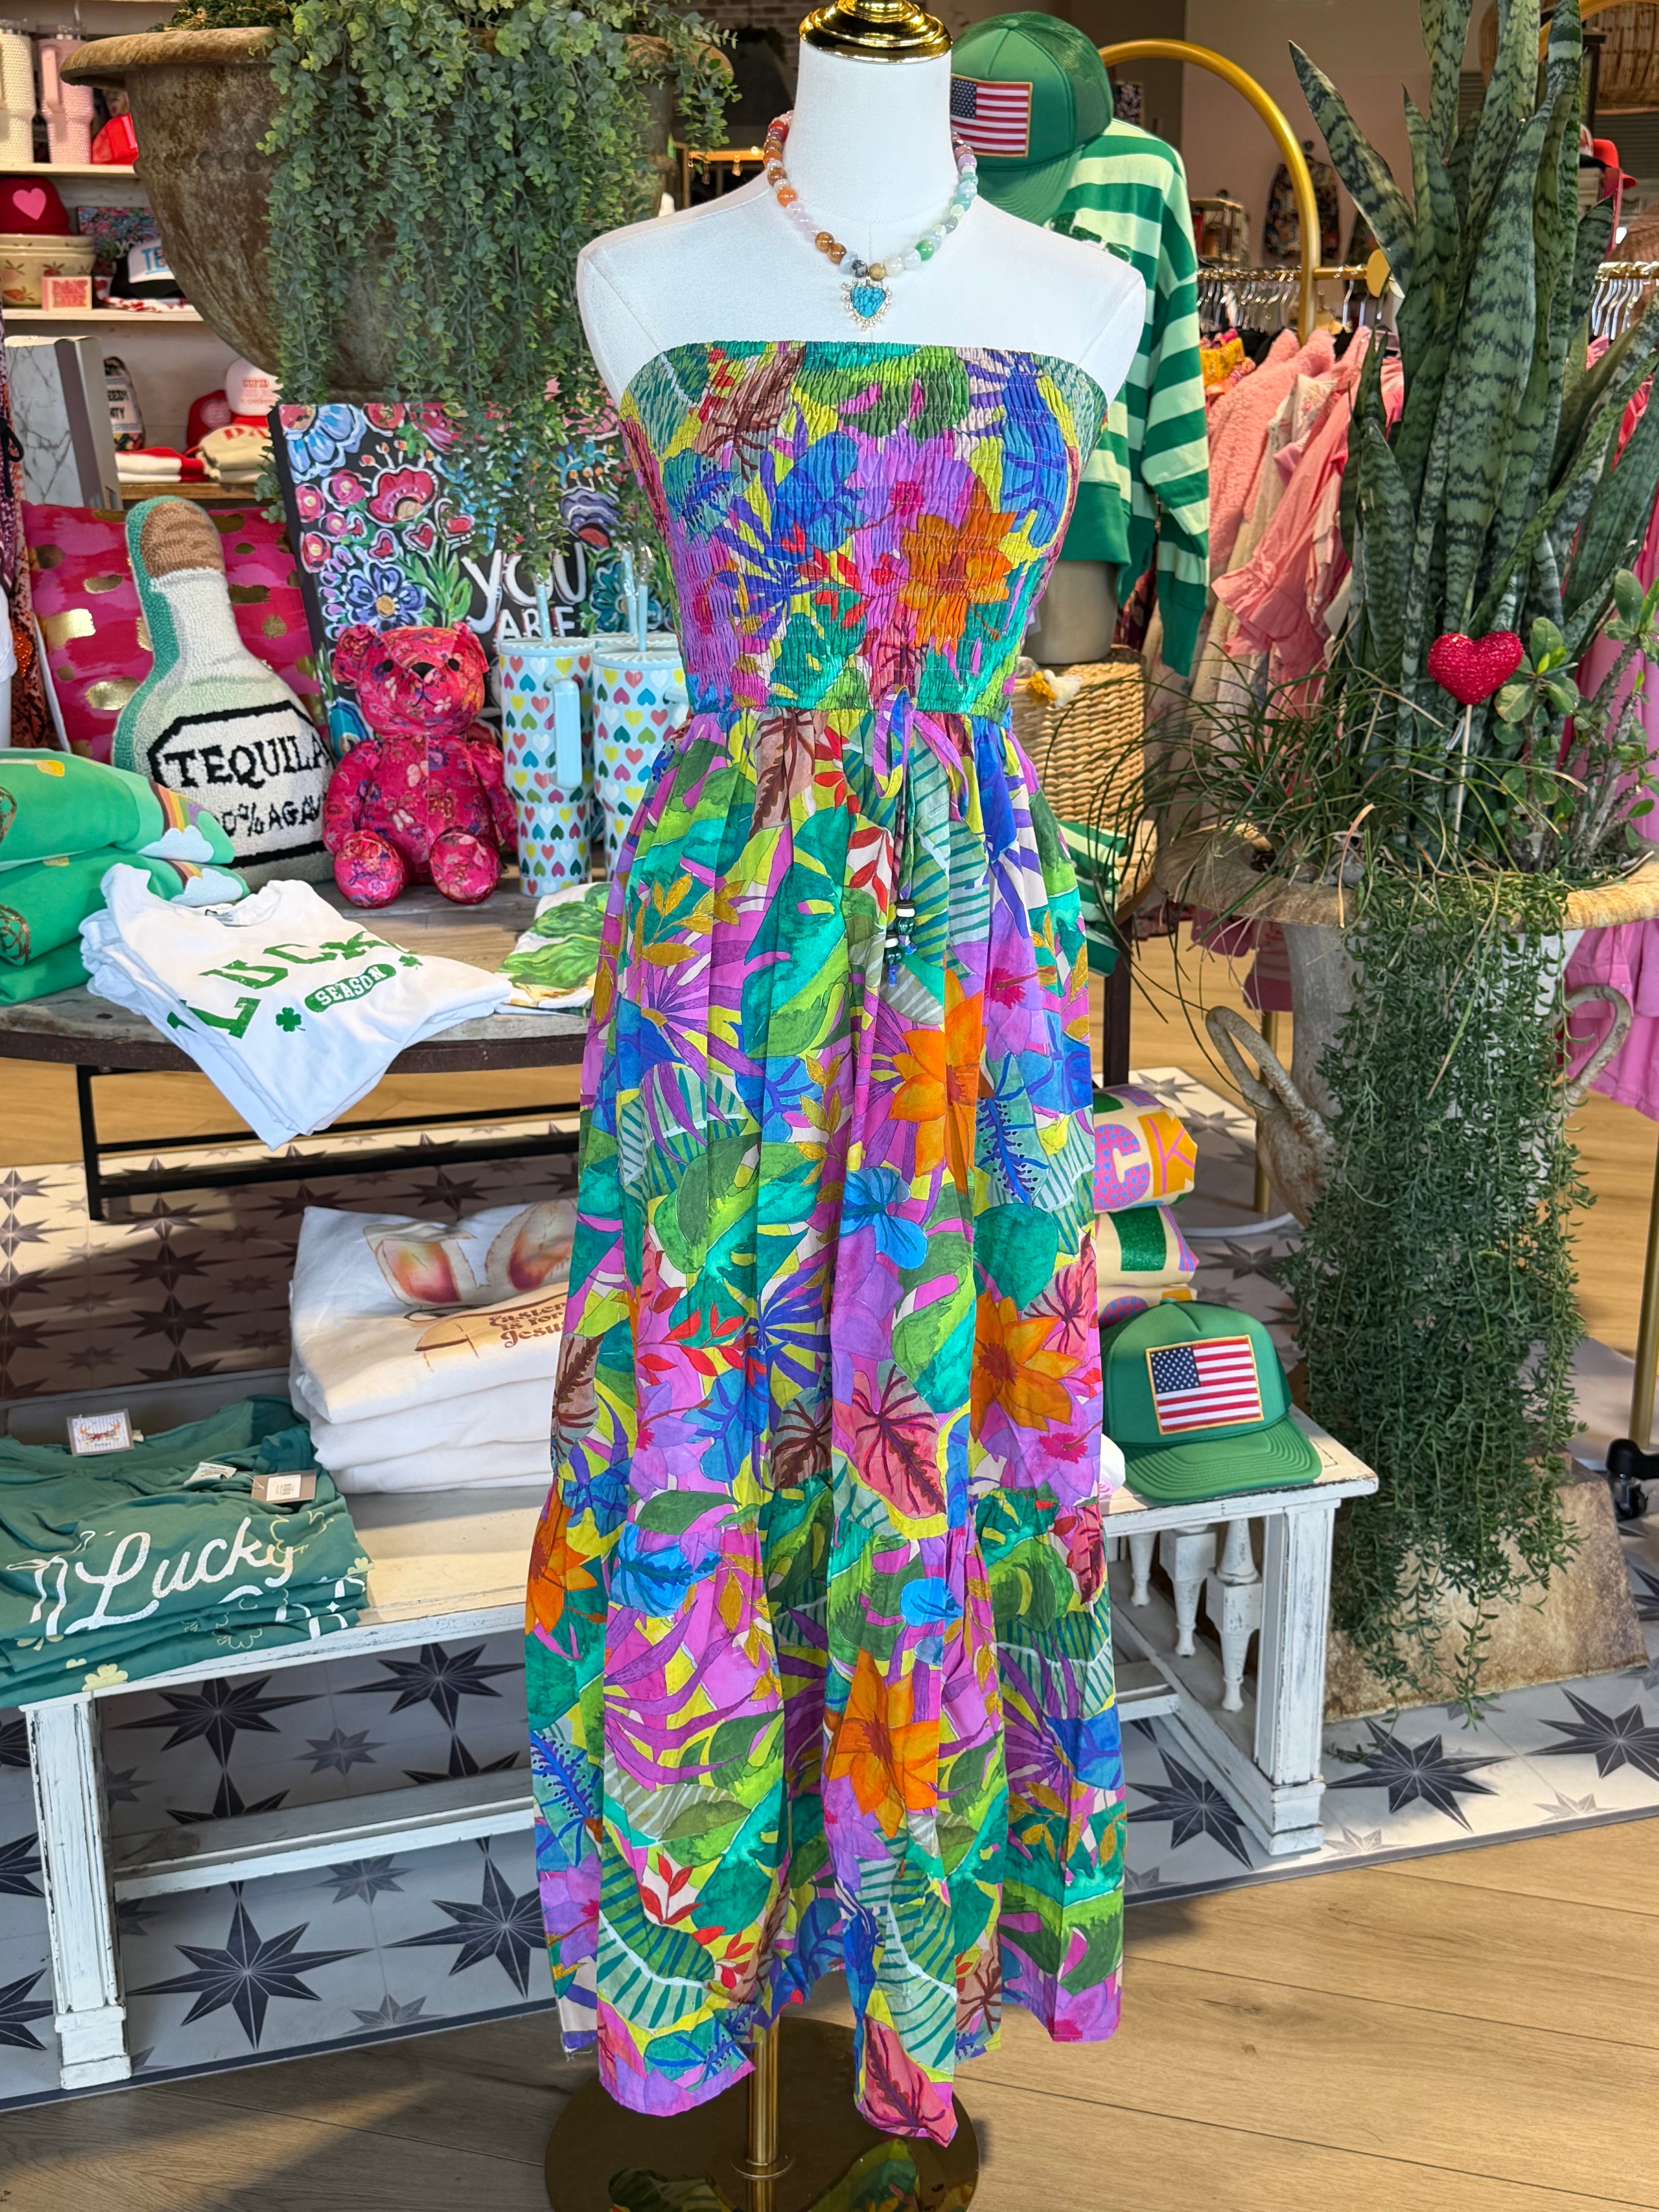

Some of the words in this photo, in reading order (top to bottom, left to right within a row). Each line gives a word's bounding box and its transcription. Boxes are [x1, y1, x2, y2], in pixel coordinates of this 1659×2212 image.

[460, 542, 587, 634] YOU
[163, 734, 329, 789] TEQUILA
[213, 803, 264, 837] 0%
[270, 794, 328, 830] AGAV
[315, 966, 387, 1006] SEASON
[500, 1321, 564, 1348] Jesu
[501, 1320, 523, 1331] is
[528, 1312, 563, 1326] for
[64, 1517, 294, 1635] Lucky
